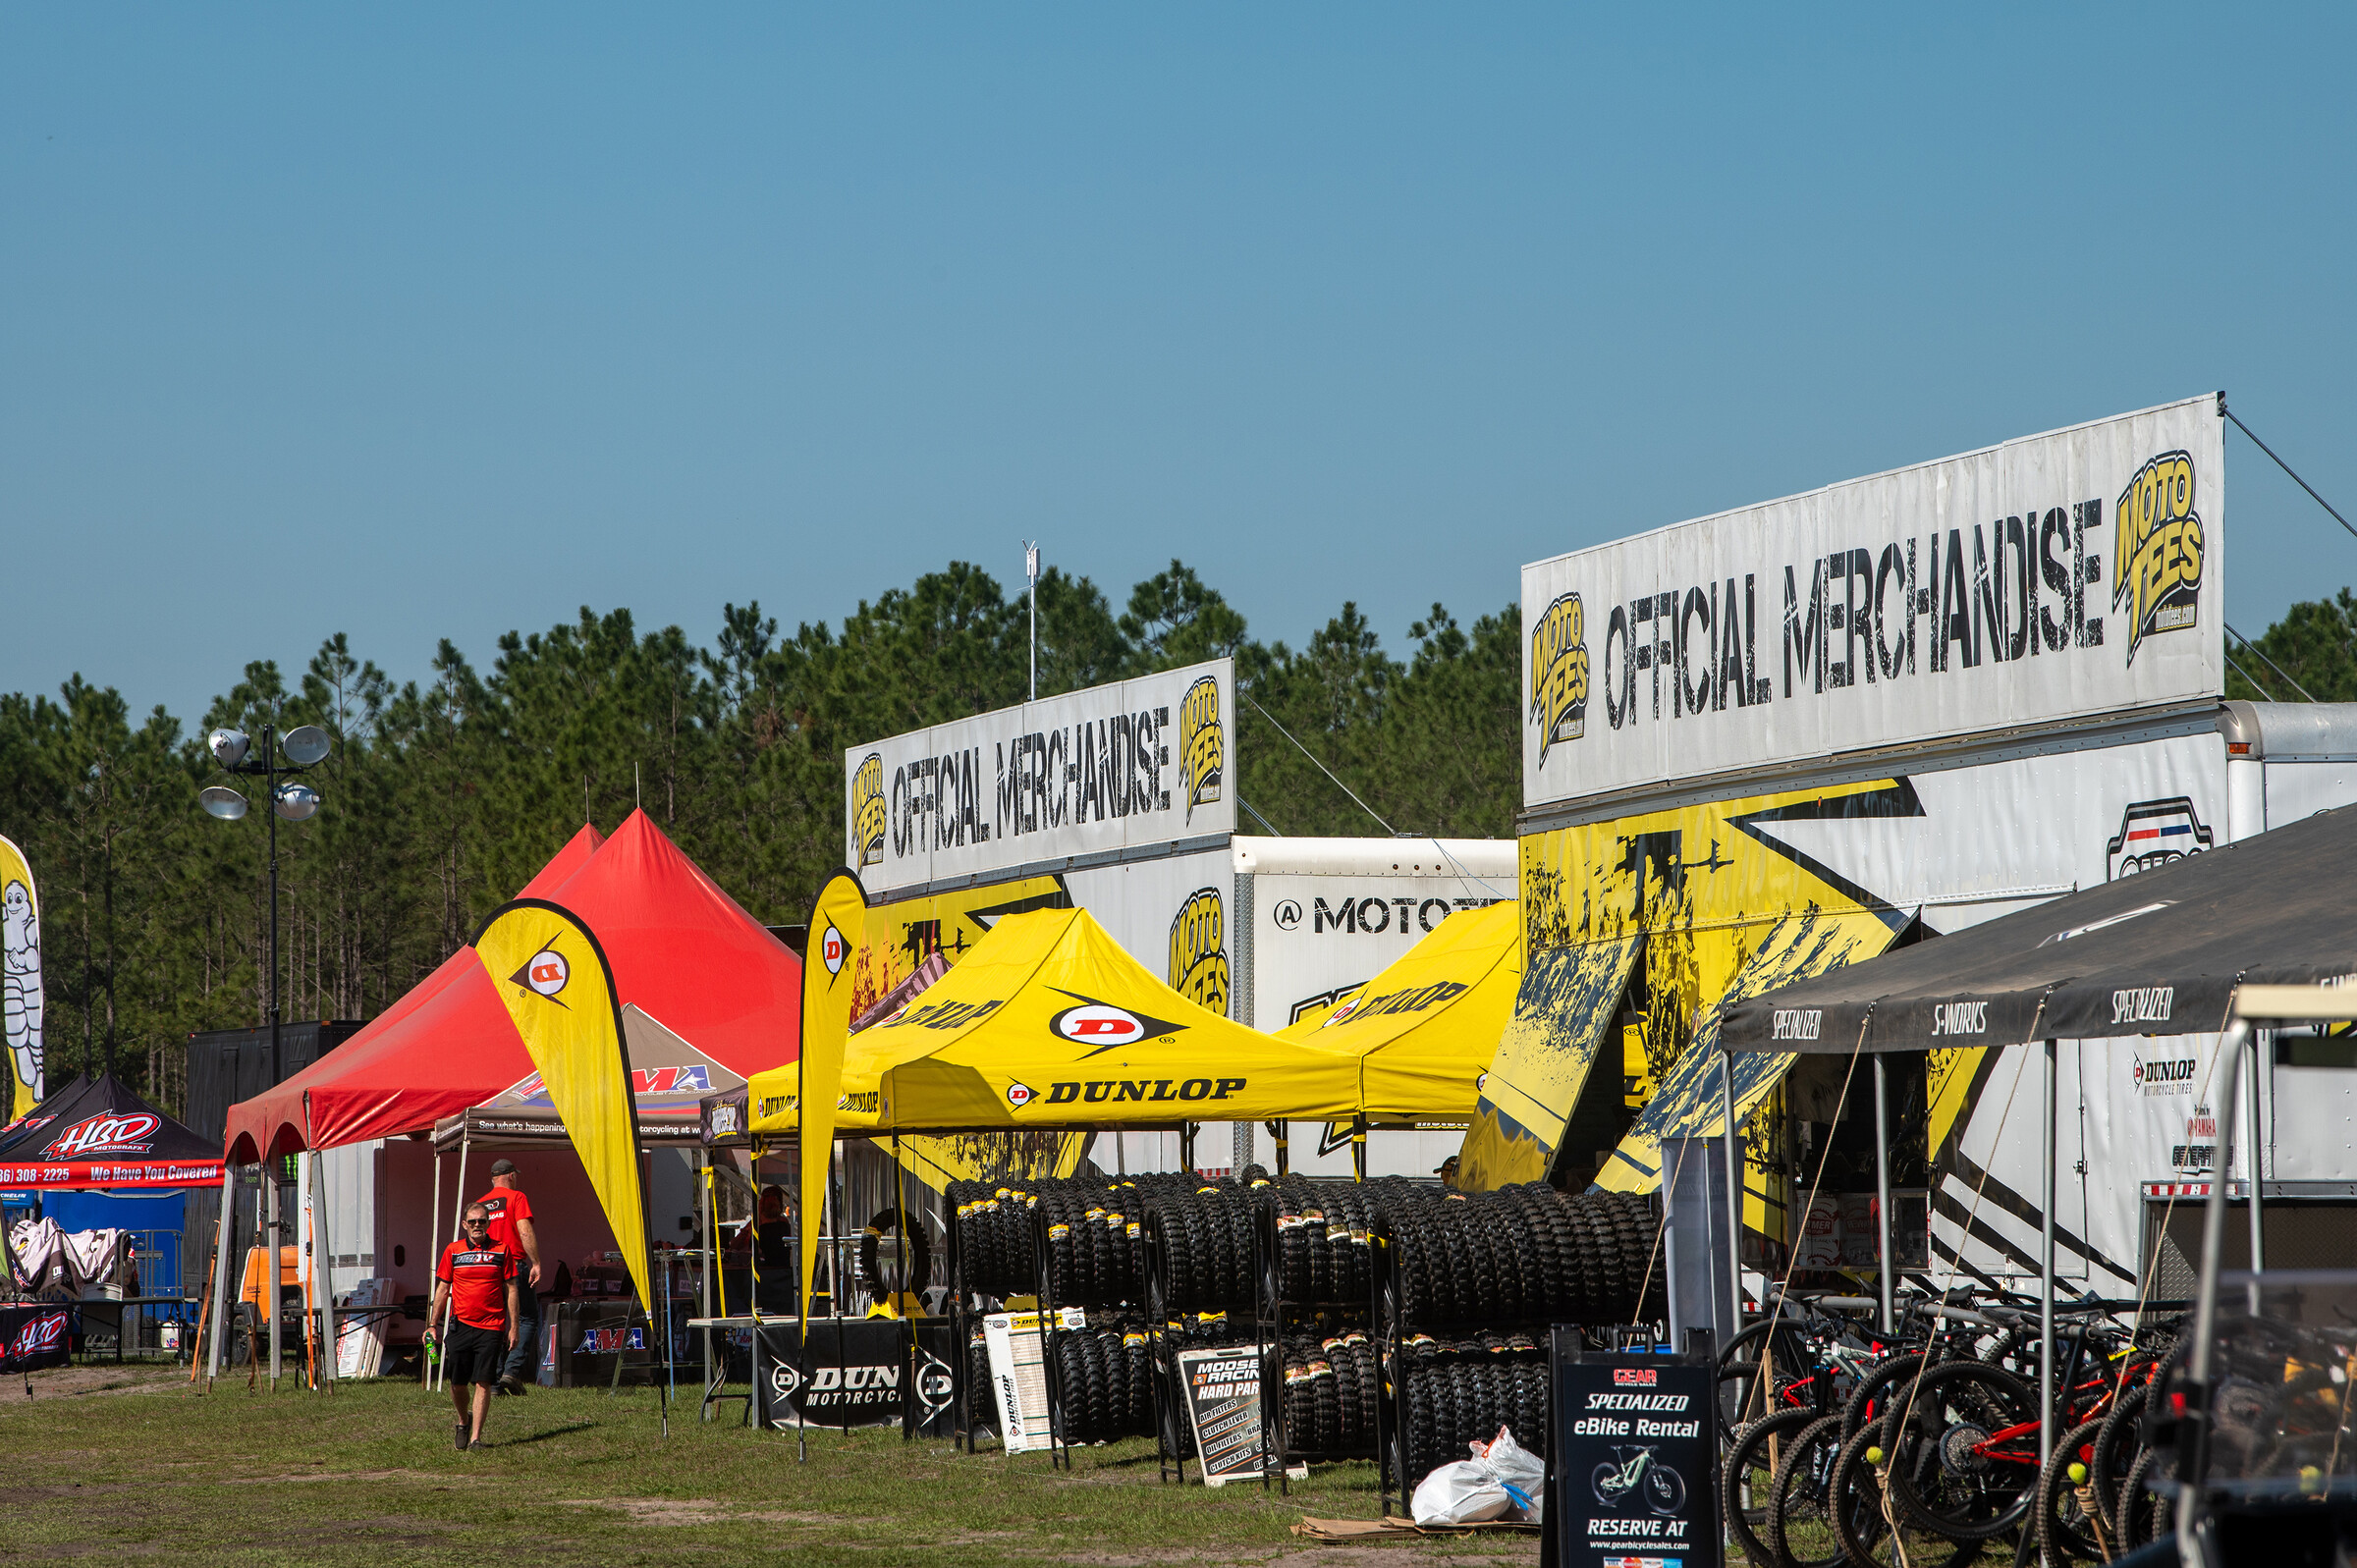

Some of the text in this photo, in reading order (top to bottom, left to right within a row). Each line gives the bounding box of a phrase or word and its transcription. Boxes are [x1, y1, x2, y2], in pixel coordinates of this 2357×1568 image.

[2116, 460, 2192, 591] MOTO
[2129, 520, 2202, 647] TEES
[1605, 498, 2104, 730] OFFICIAL MERCHANDISE
[1532, 600, 1582, 707] MOTO
[1541, 649, 1588, 752] TEES
[1180, 682, 1218, 771] MOTO
[1186, 725, 1223, 811] TEES
[893, 706, 1171, 858] OFFICIAL MERCHANDISE
[852, 757, 883, 838] MOTO
[857, 796, 886, 876] TEES
[1171, 894, 1223, 990] MOTO
[1180, 956, 1229, 1017] EES
[1772, 1009, 1822, 1040] SPECIALIZED
[1932, 1001, 1988, 1036] S-WORKS
[631, 1064, 717, 1093] MA
[2145, 1059, 2196, 1082] DUNLOP
[1045, 1078, 1247, 1104] DUNLOP
[2176, 1083, 2193, 1095] TIRES
[479, 1120, 494, 1130] See
[496, 1120, 522, 1131] what's
[525, 1122, 567, 1134] happening
[639, 1124, 679, 1135] torcycling
[90, 1166, 110, 1181] We
[113, 1165, 141, 1180] Have
[144, 1165, 166, 1180] You
[168, 1164, 217, 1179] Covered
[809, 1365, 900, 1390] DUN
[1196, 1359, 1259, 1375] MOOSE
[1207, 1370, 1260, 1383] RACIN
[1614, 1369, 1657, 1382] GEAR
[805, 1389, 902, 1406] MOTORCYC
[1002, 1375, 1016, 1425] DUNLOP
[1197, 1380, 1260, 1401] HARD PAR
[1585, 1393, 1689, 1412] SPECIALIZED
[1199, 1399, 1237, 1424] AIR FILTERS
[1202, 1411, 1248, 1438] CLUTCH LEVER
[1206, 1443, 1218, 1455] OIL
[1218, 1433, 1242, 1450] FILTERS
[1247, 1424, 1261, 1436] BRA
[1573, 1417, 1699, 1437] eBike Rental
[1210, 1447, 1252, 1473] CLUTCH KITS
[1587, 1519, 1688, 1537] RESERVE AT
[1590, 1541, 1689, 1550] www.gearbicyclesales.com
